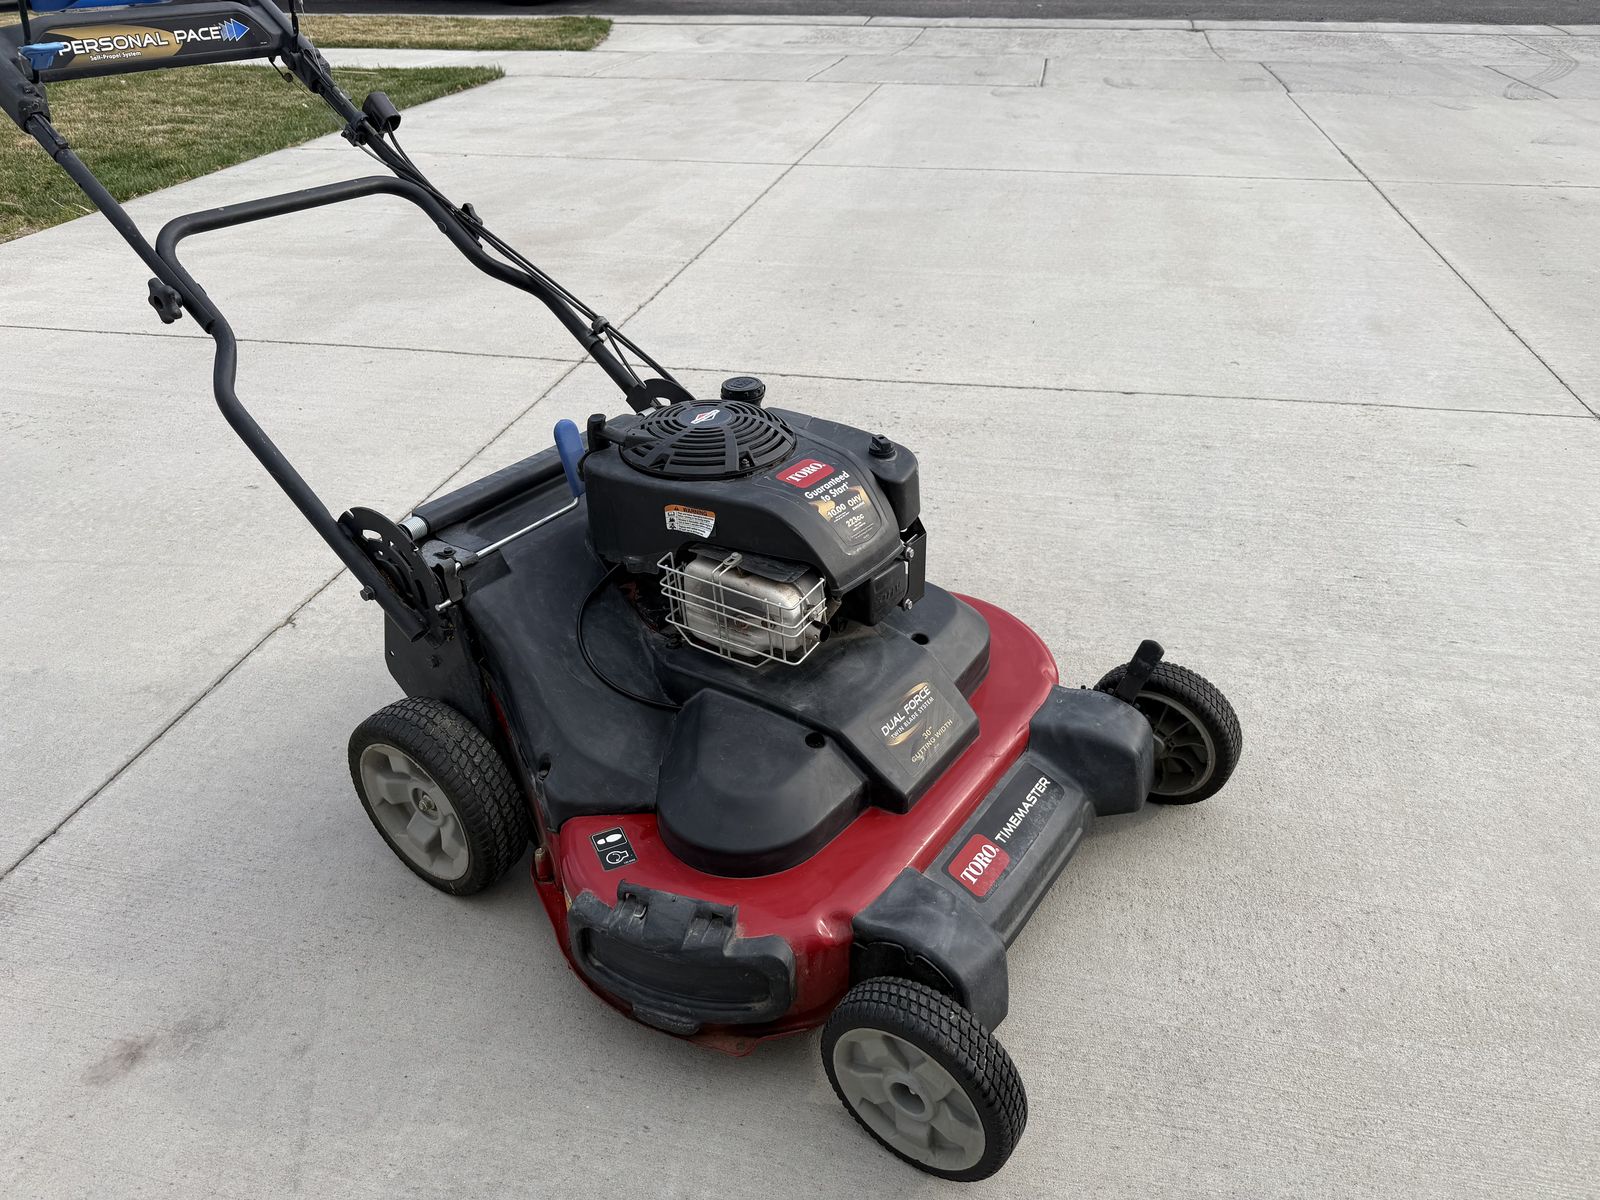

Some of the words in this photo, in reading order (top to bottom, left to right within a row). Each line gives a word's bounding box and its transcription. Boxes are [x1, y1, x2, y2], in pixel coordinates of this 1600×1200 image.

[58, 32, 169, 56] PERSONAL
[173, 26, 221, 44] PACE
[122, 51, 142, 59] System
[786, 462, 824, 482] TORO
[804, 470, 850, 499] Guaranteed
[820, 495, 831, 503] to
[827, 503, 847, 518] 10.00
[847, 494, 862, 507] OHV
[845, 513, 865, 527] 223cc
[881, 712, 905, 737] DUAL
[903, 685, 931, 715] FORCE
[890, 725, 905, 739] TWIN
[903, 711, 919, 727] BLADE
[917, 696, 935, 714] SYSTEM
[911, 737, 936, 763] CUTTING
[934, 718, 953, 738] WIDTH
[994, 776, 1051, 843] TIMEMASTER
[960, 844, 998, 885] TORO
